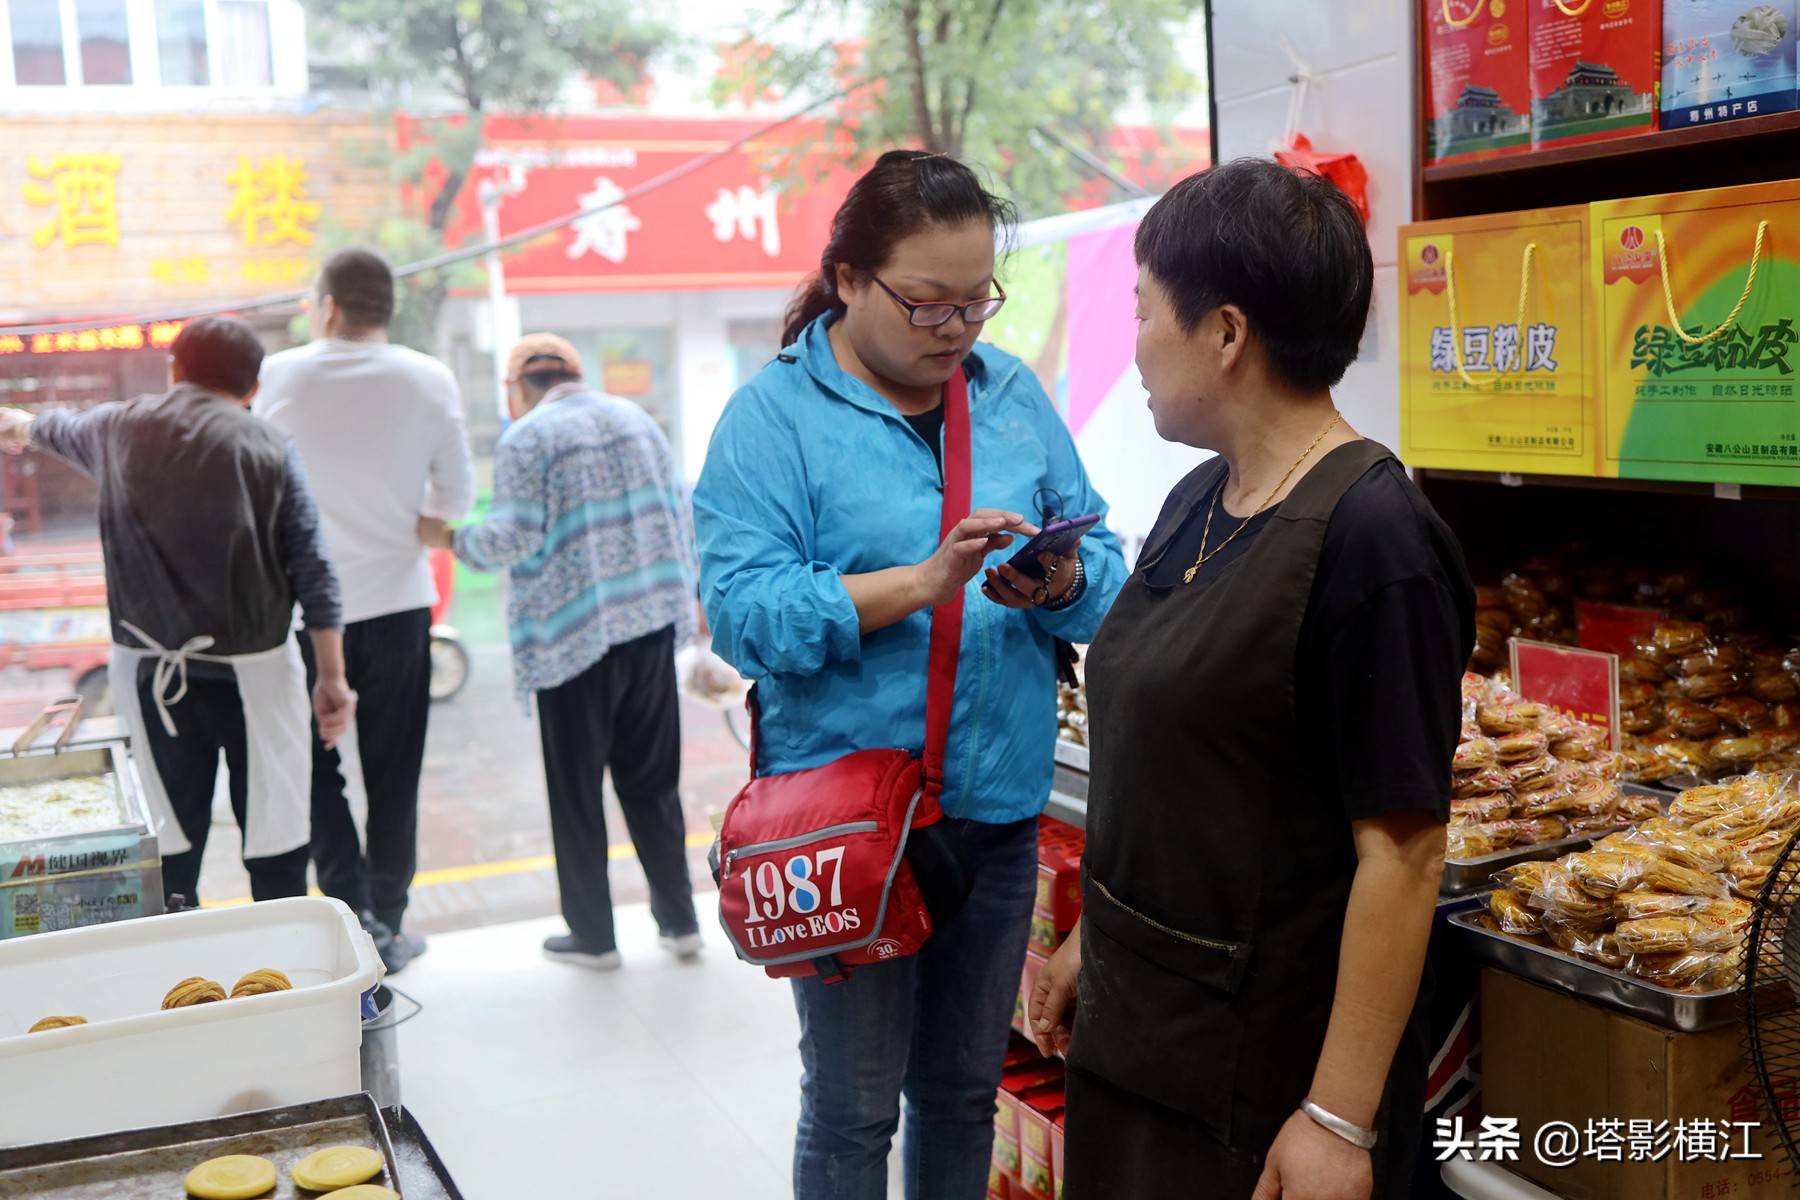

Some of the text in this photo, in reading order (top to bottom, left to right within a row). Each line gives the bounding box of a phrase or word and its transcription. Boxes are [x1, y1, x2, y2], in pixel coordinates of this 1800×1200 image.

[23, 153, 322, 249] 酒楼
[1431, 322, 1557, 373] 绿豆粉皮
[1631, 318, 1799, 378] 绿豆粉皮
[740, 846, 845, 923] 1987
[745, 908, 860, 948] I Love EOS
[876, 944, 893, 955] 30
